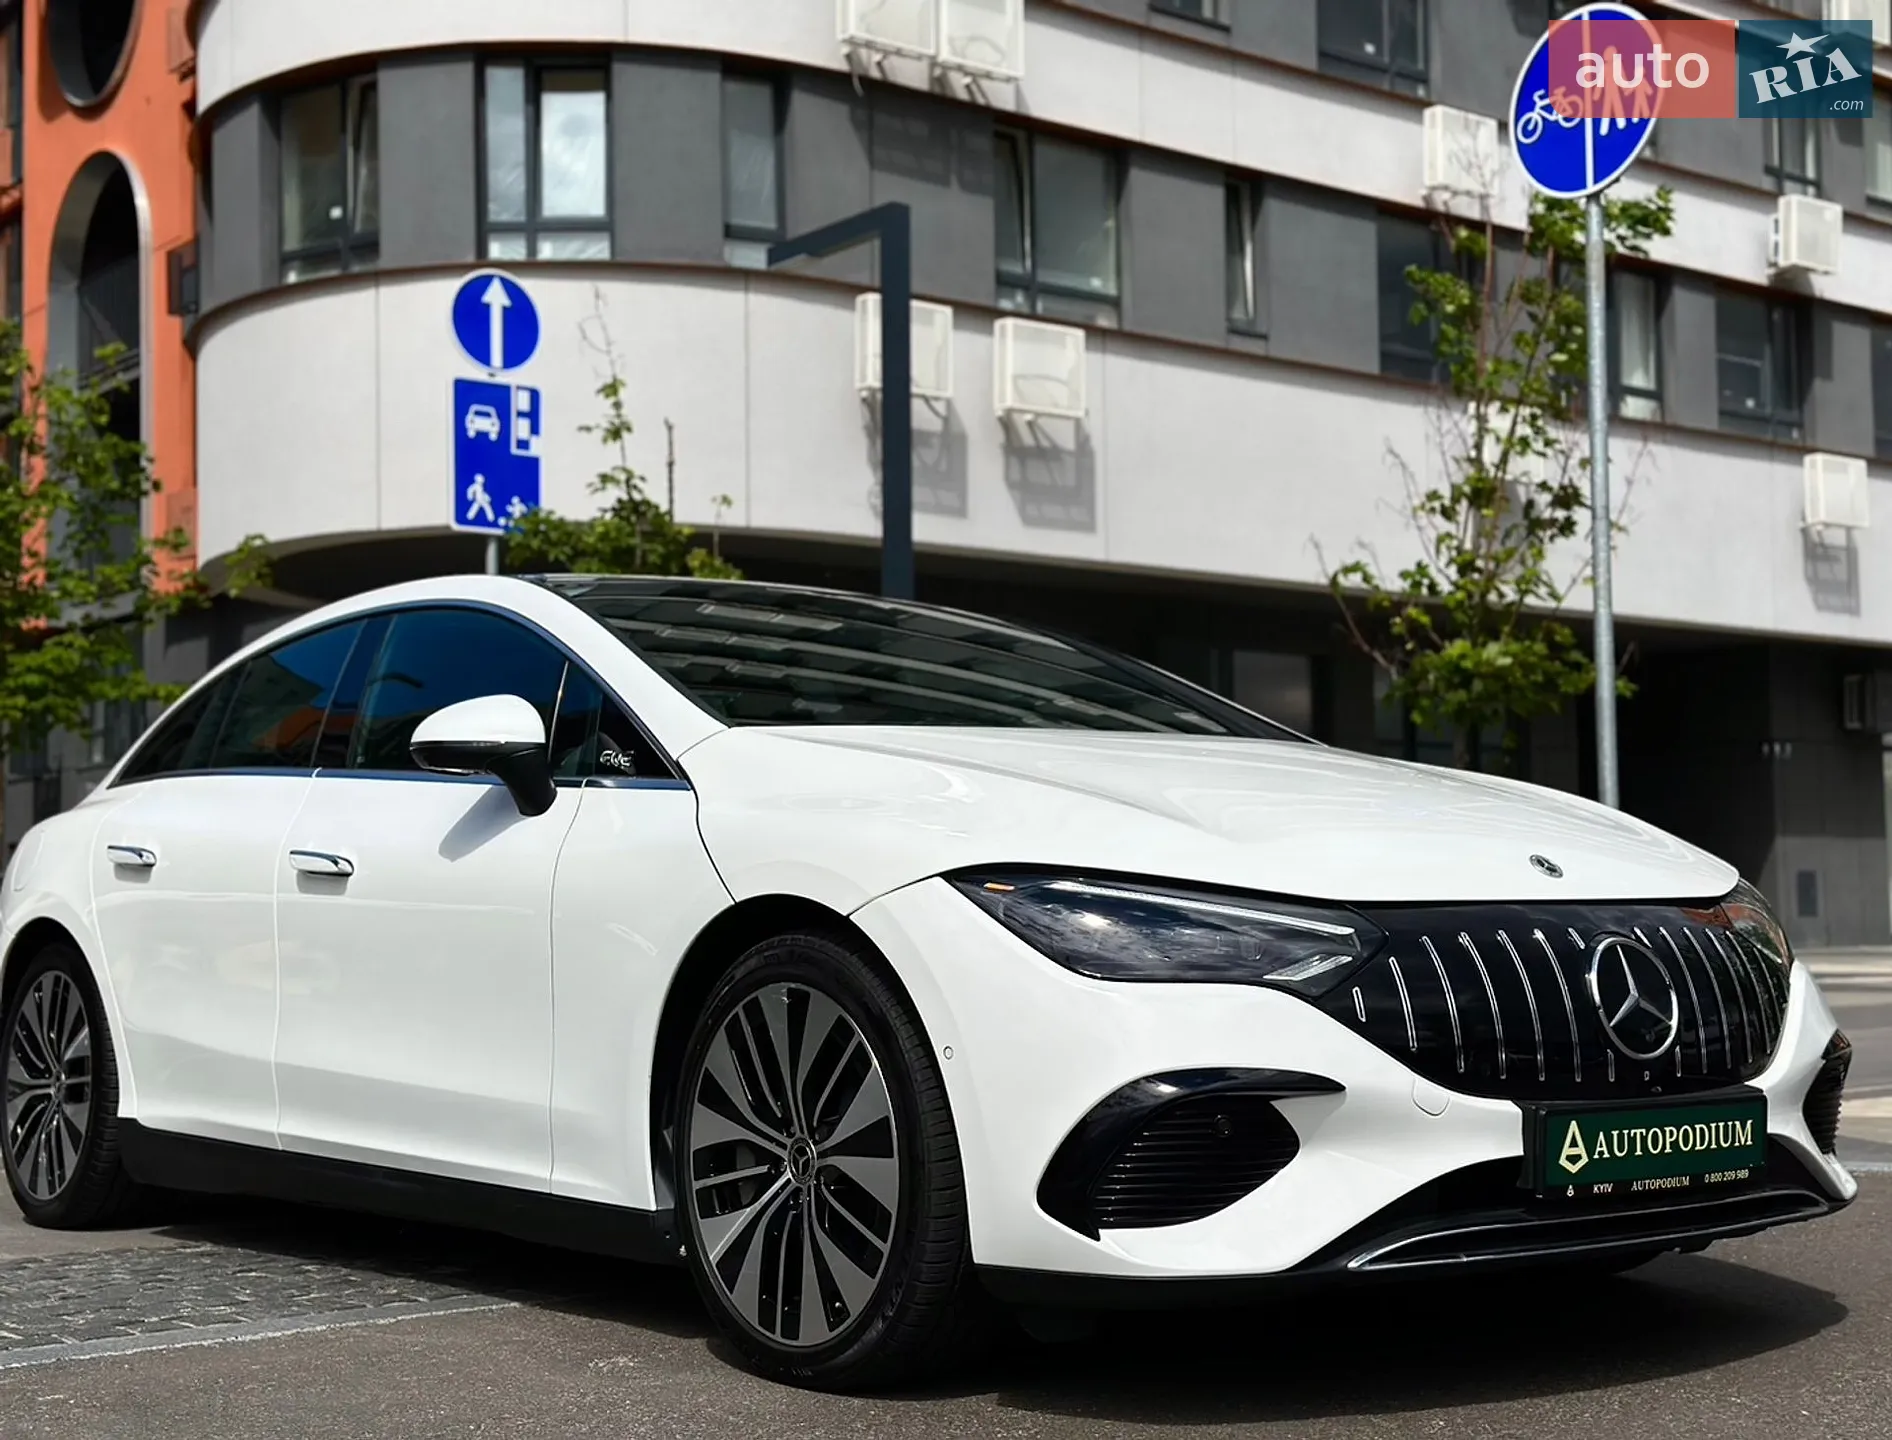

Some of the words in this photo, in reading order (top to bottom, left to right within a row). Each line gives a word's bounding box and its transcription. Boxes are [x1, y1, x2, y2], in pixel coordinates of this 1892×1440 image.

[1593, 1119, 1753, 1159] AUTOPODIUM
[1593, 1182, 1613, 1194] KYIV
[1630, 1175, 1690, 1192] AUTOPODIUM
